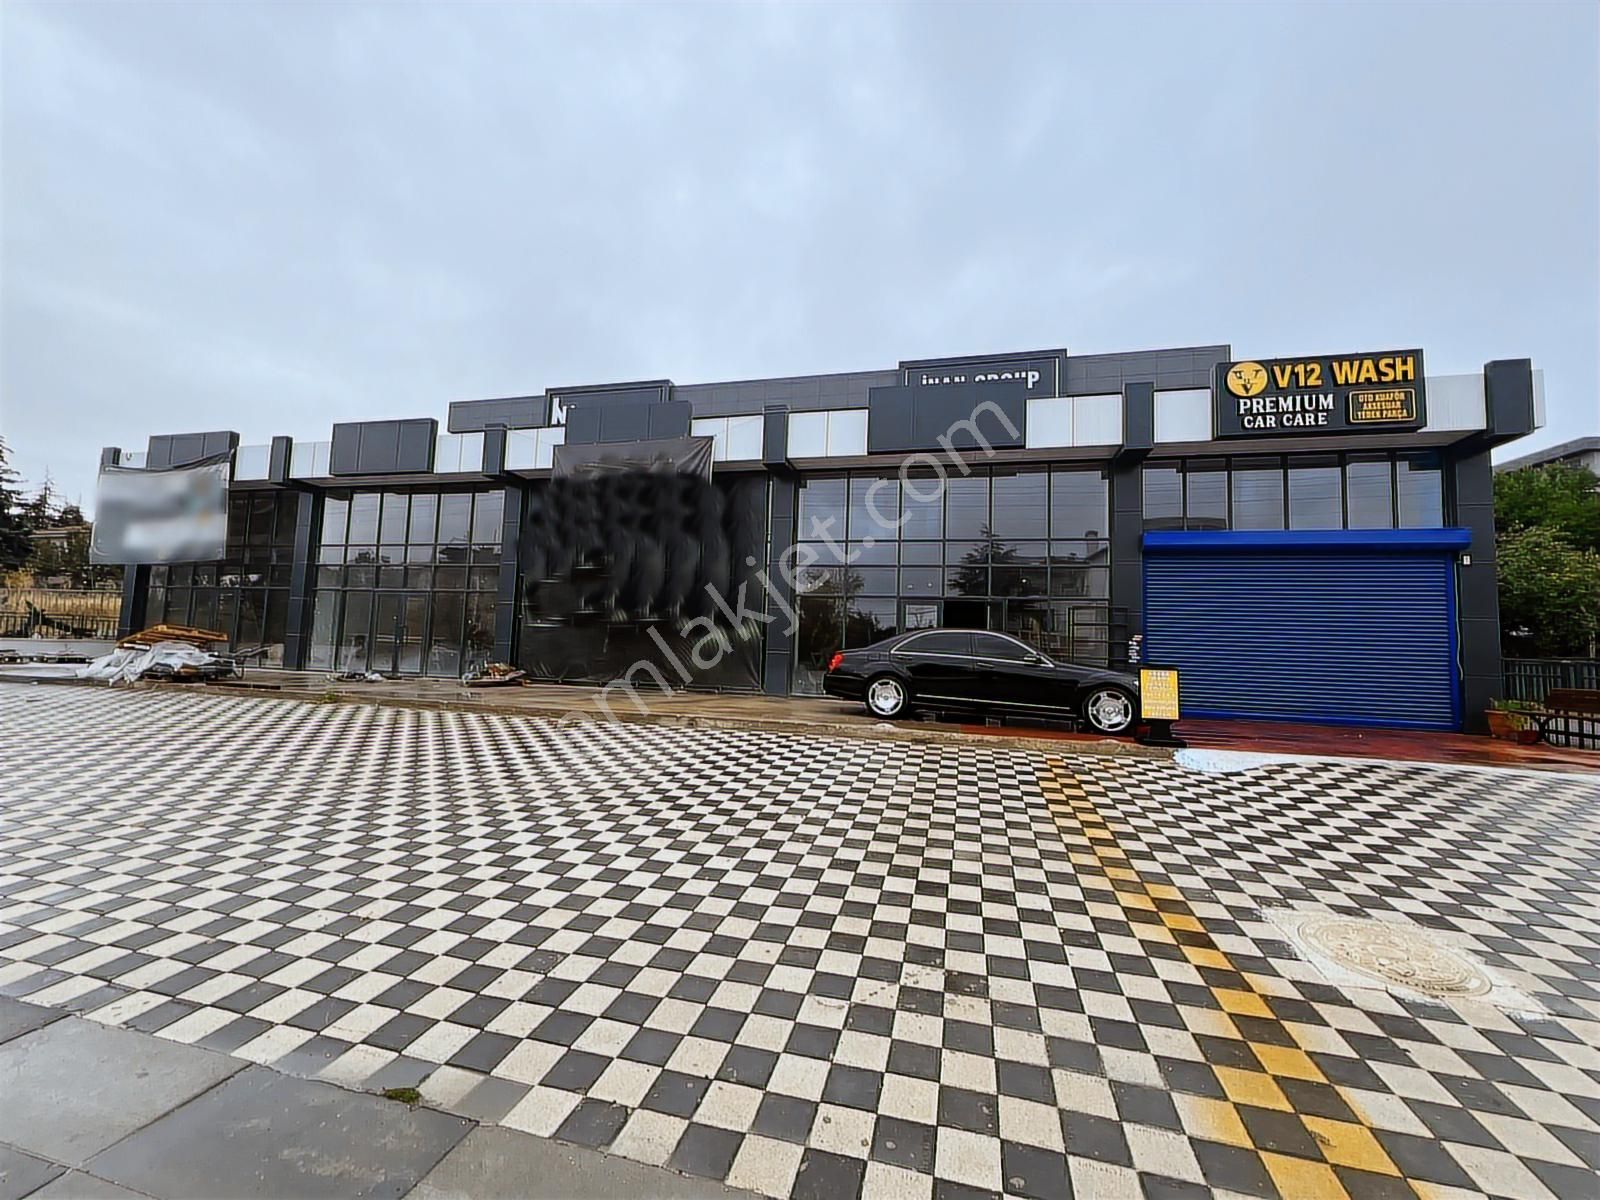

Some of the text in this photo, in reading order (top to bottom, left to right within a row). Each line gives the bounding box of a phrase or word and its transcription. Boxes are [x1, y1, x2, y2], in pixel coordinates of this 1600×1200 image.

[1272, 356, 1414, 388] V12 WASH
[1239, 394, 1335, 414] PREMIUM
[1243, 412, 1328, 428] CAR CARE
